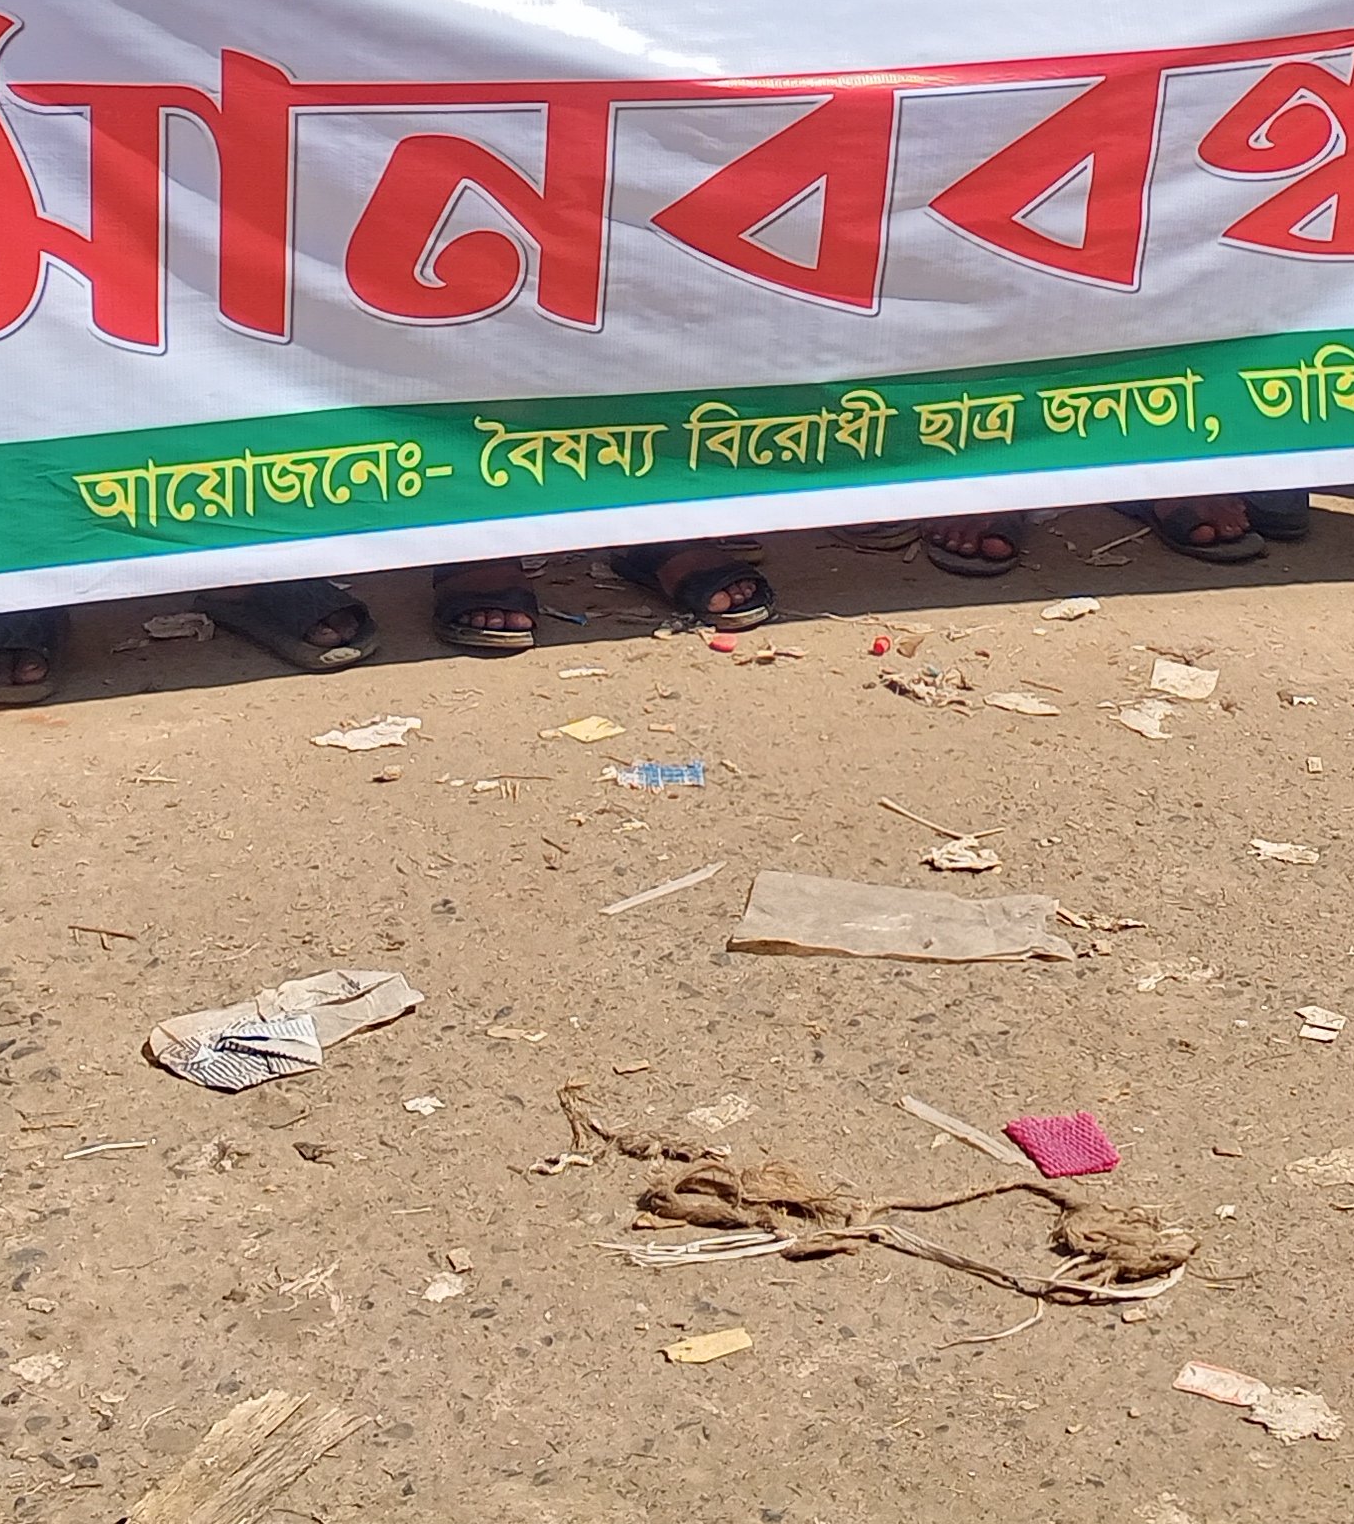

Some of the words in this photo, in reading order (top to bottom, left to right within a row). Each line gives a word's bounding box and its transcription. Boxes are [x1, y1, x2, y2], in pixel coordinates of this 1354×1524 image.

[473, 414, 669, 490] বৈষম্য
[682, 388, 897, 474] বিরোধী
[914, 392, 1024, 457] ছাত্র
[1037, 367, 1221, 442] জনতা,
